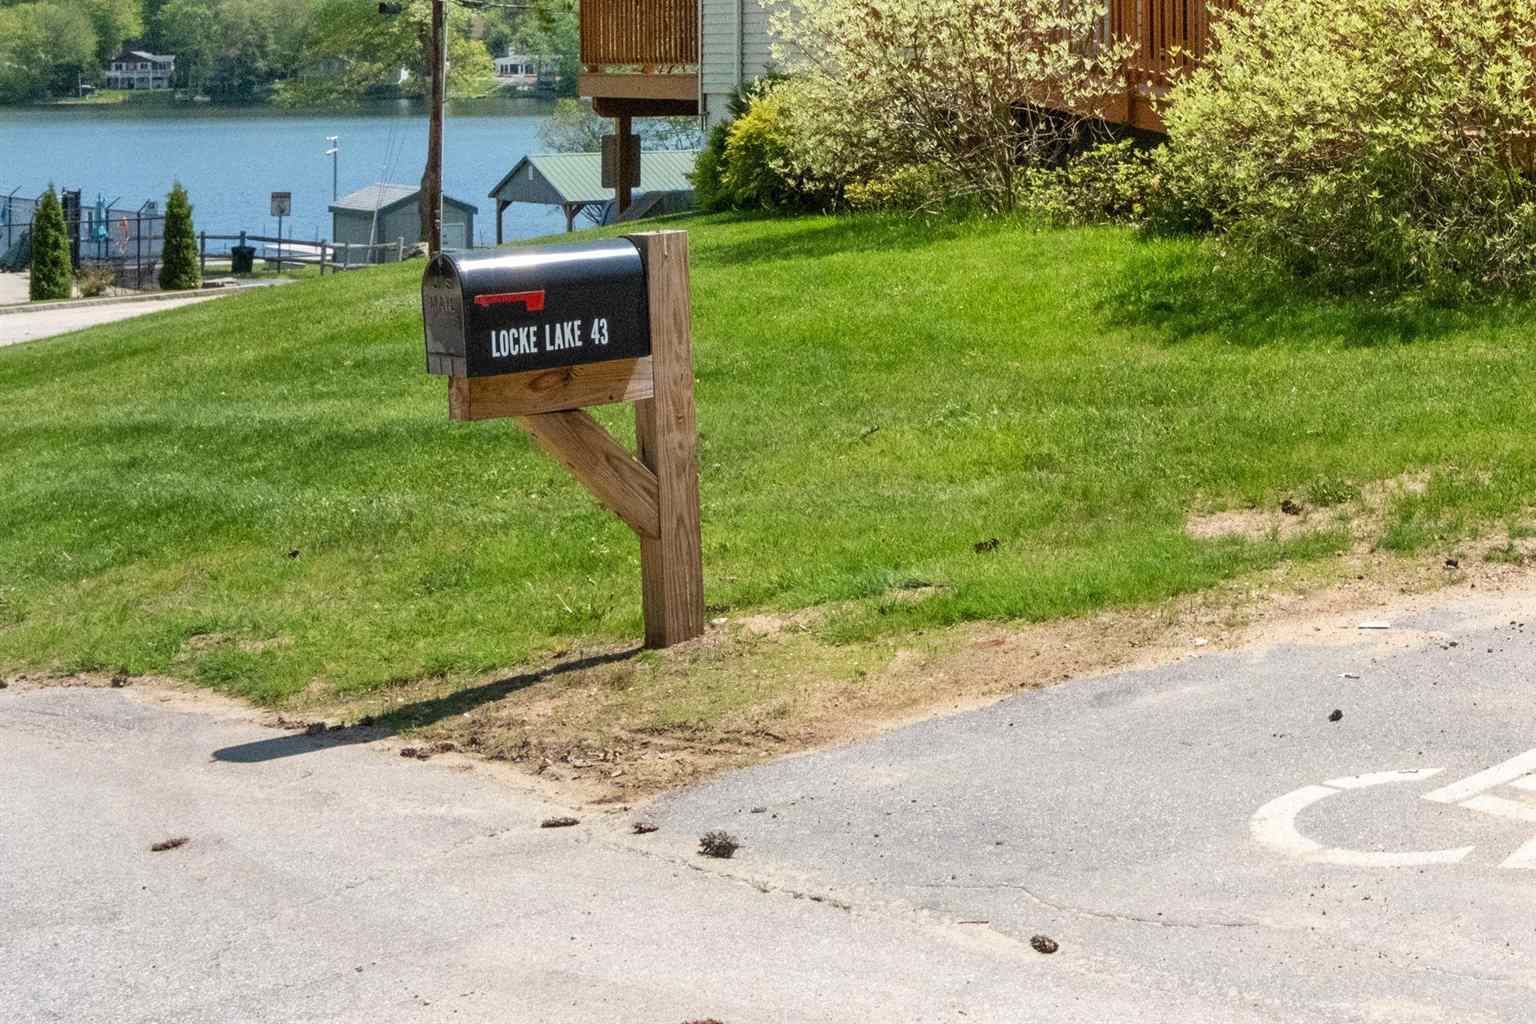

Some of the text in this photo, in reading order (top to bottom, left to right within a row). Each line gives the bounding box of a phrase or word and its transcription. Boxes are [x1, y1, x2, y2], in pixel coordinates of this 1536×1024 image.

[491, 318, 609, 358] LOCKE LAKE 43
